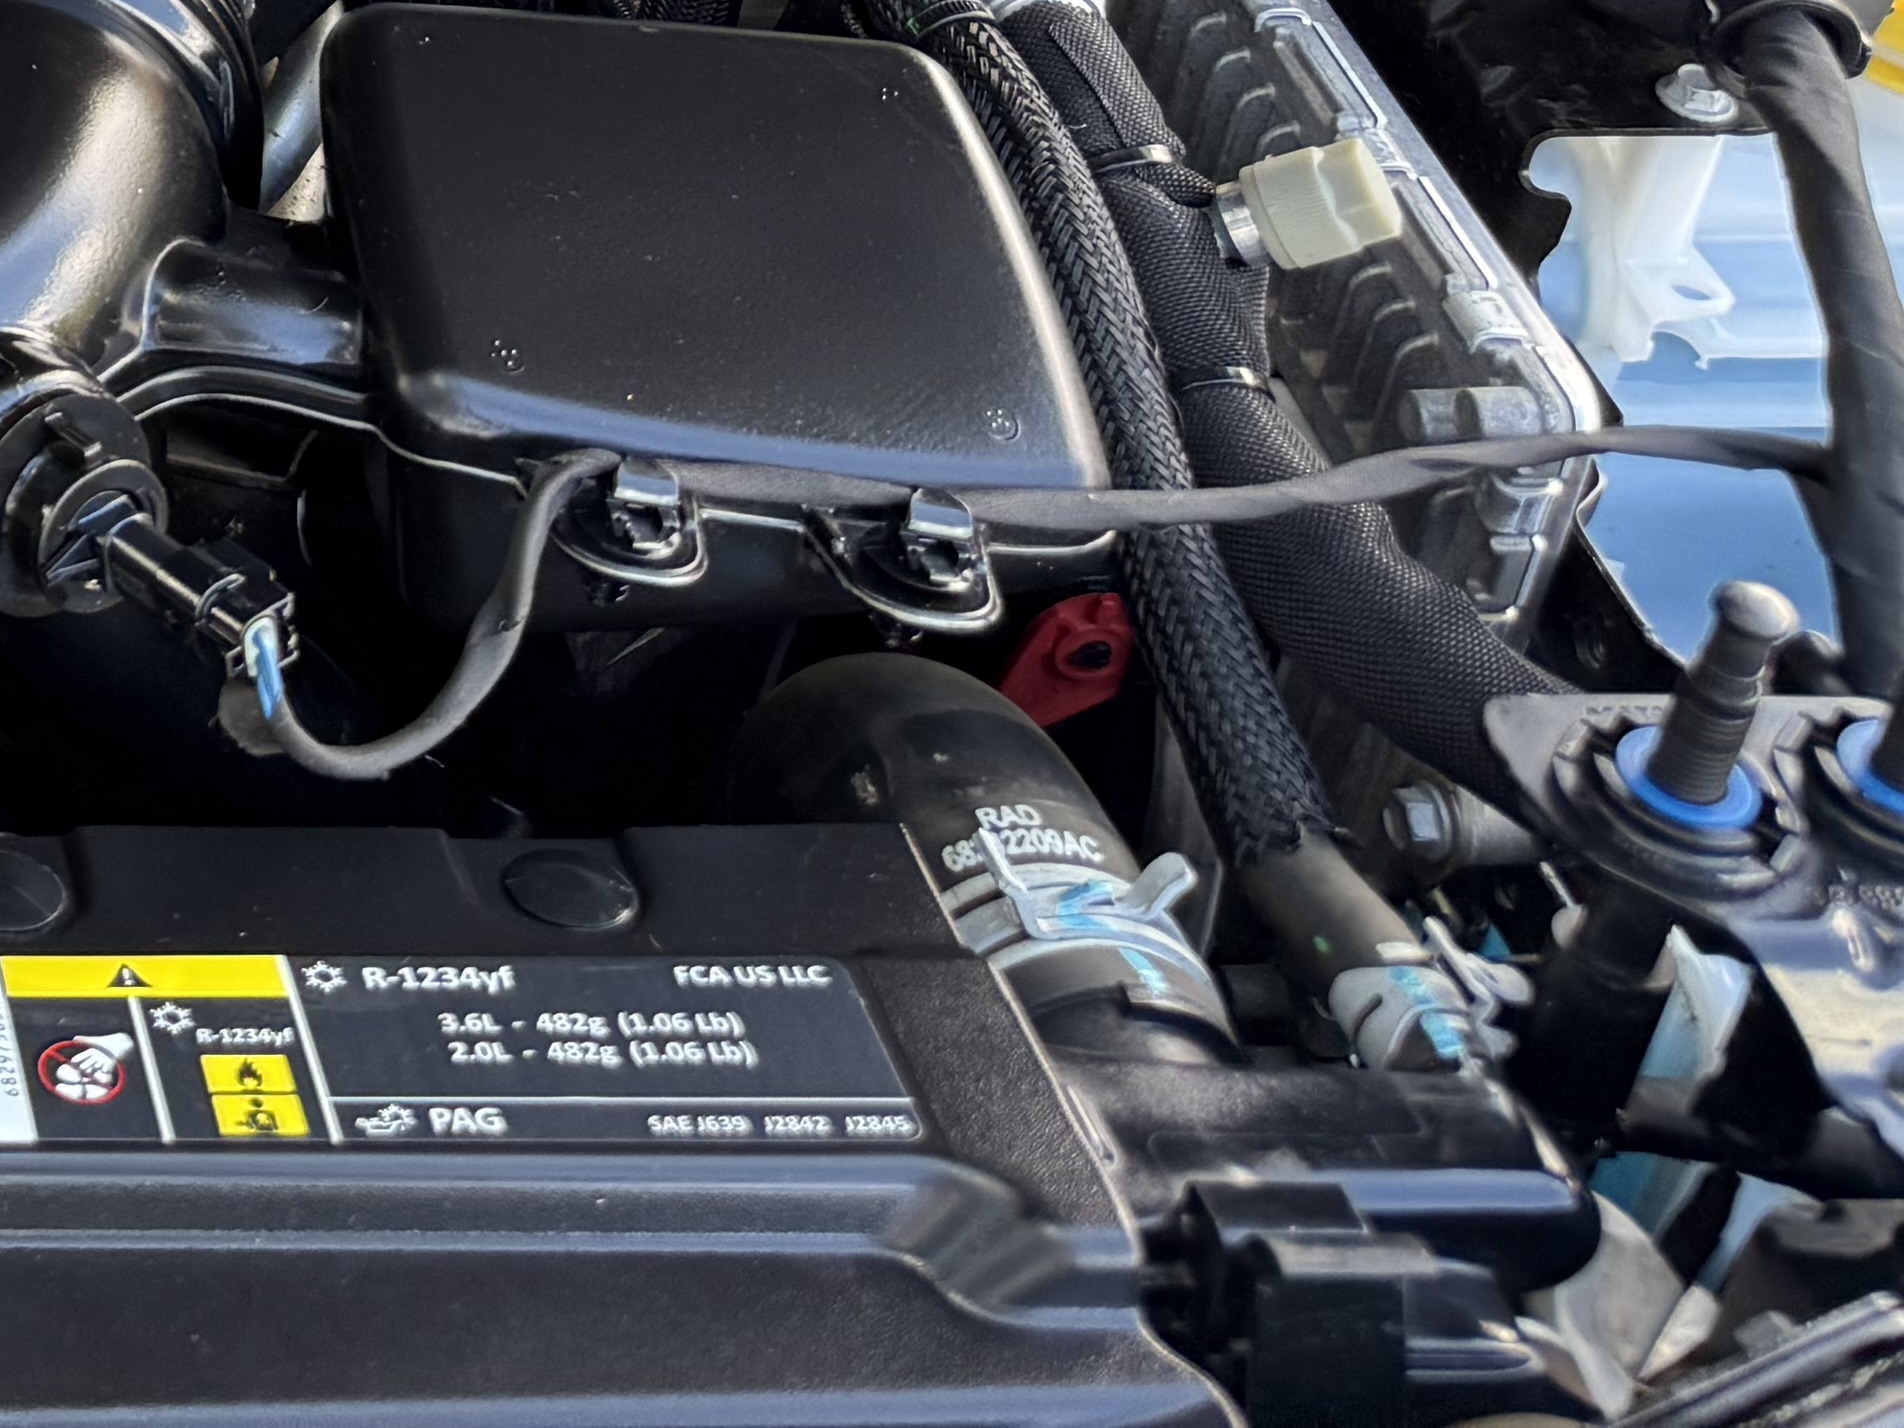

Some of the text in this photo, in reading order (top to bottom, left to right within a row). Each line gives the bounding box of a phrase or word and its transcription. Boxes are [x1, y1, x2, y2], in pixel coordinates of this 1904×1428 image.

[975, 804, 1042, 829] RAD
[942, 828, 1105, 873] 682209AC
[362, 965, 516, 995] R-1234yf
[673, 965, 833, 987] FCA US LLC
[197, 1024, 295, 1049] R-1234yf
[438, 1012, 504, 1035] 3.6L
[535, 1011, 610, 1039] 482g
[618, 1011, 694, 1037] (1.06
[695, 1011, 746, 1038] Lb)
[448, 1041, 515, 1064] 2.0L
[546, 1041, 622, 1069] 482g
[629, 1040, 707, 1068] (1.06
[707, 1040, 759, 1069] Lb)
[428, 1107, 509, 1135] PAG
[647, 1114, 918, 1137] SAE J639 J2842 J2845
